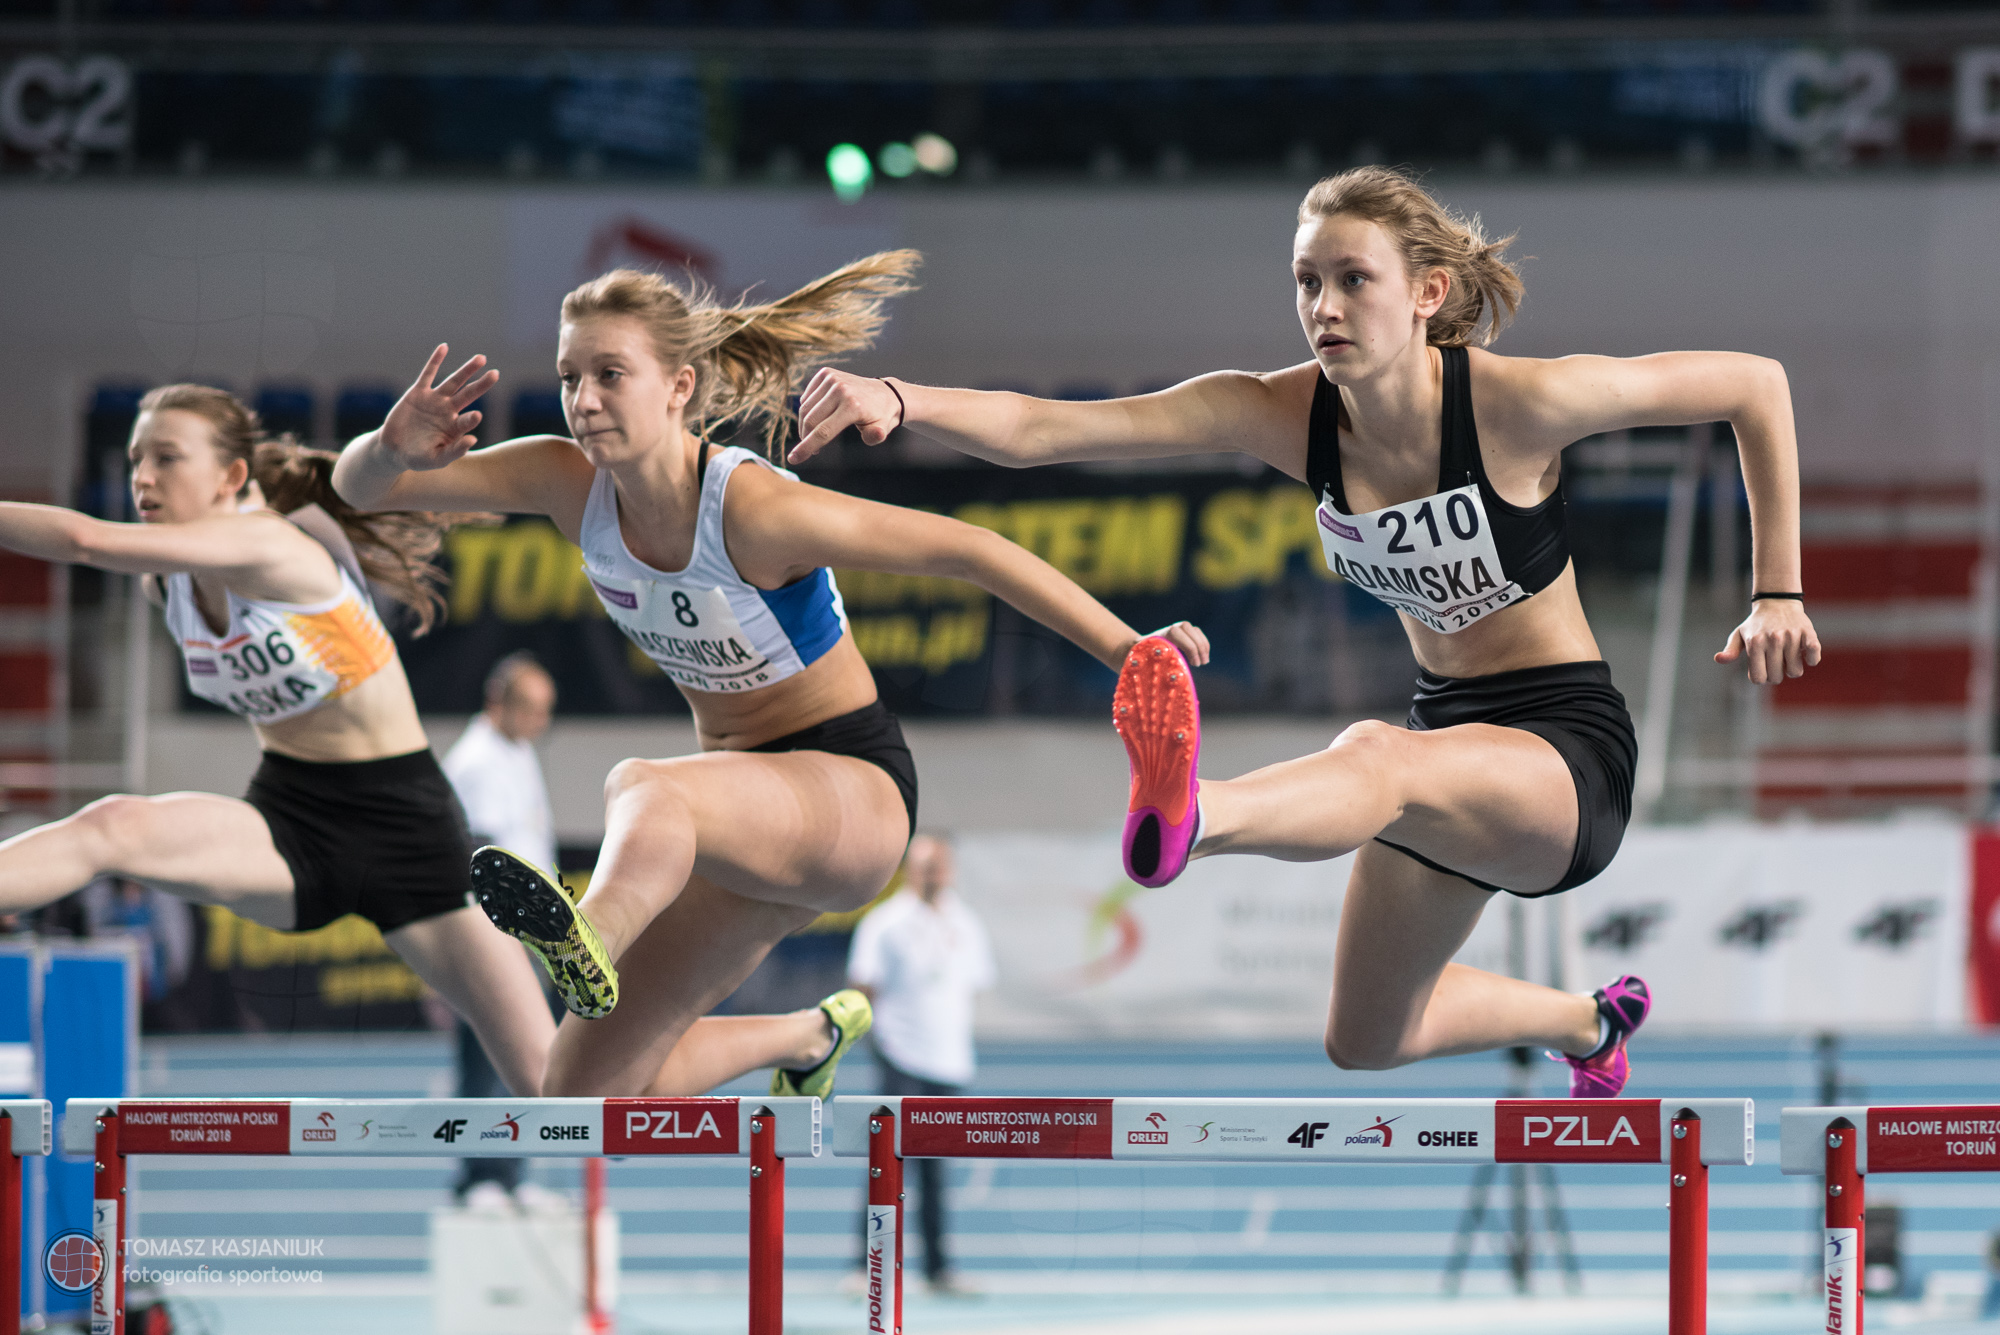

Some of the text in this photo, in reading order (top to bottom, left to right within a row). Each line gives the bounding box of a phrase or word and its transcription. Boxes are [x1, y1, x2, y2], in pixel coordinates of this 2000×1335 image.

[1378, 493, 1479, 554] 210
[1334, 552, 1498, 603] ADAMSKA
[671, 590, 699, 628] 8
[221, 631, 294, 681] 306
[714, 672, 770, 691] 2018
[125, 1112, 278, 1125] HALOWE MISTRZOSTWA POLSKI
[626, 1111, 722, 1140] PZLA
[910, 1111, 1098, 1126] HALOWE MISTRZOSTWA POLSKI
[170, 1127, 232, 1142] TORUŃ 2018
[304, 1130, 335, 1140] ORLEN
[433, 1119, 468, 1143] 4F
[540, 1126, 590, 1141] OSHEE
[966, 1127, 1040, 1144] TORUŃ 2018
[1129, 1132, 1166, 1143] ORLEN
[1287, 1122, 1330, 1149] 4F
[1523, 1115, 1641, 1147] PZLA
[1878, 1121, 1942, 1136] HALOWE
[1345, 1133, 1382, 1147] polanik
[1417, 1130, 1479, 1148] OSHEE
[1945, 1137, 1996, 1155] TORUŃ
[867, 1246, 886, 1334] polanik
[1825, 1272, 1843, 1335] lanik
